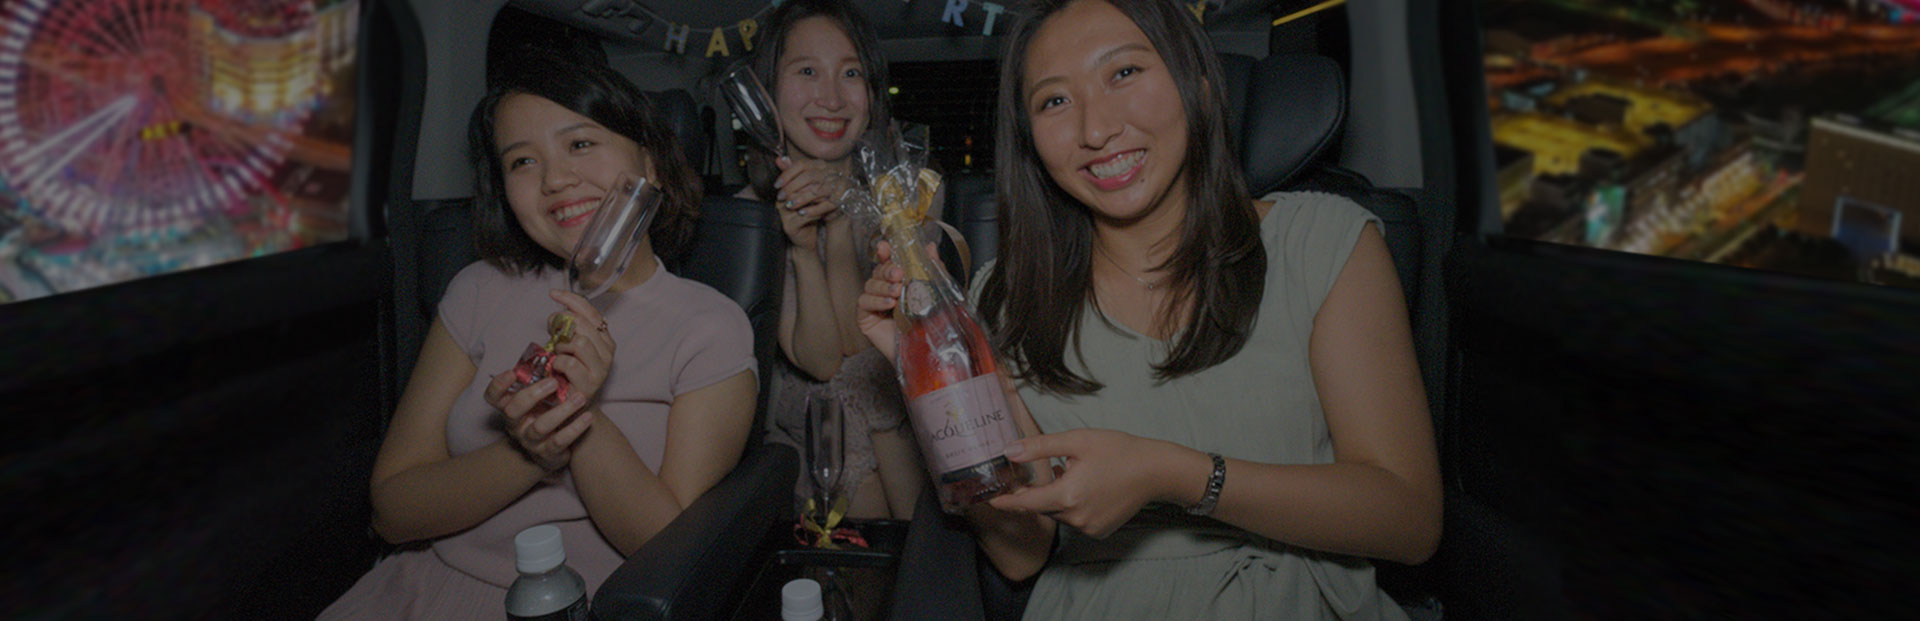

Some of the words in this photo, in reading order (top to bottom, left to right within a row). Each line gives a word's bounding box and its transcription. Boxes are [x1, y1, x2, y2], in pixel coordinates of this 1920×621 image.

[665, 1, 780, 58] HAP
[941, 0, 1006, 36] RT
[929, 409, 1005, 441] ACQUELINE
